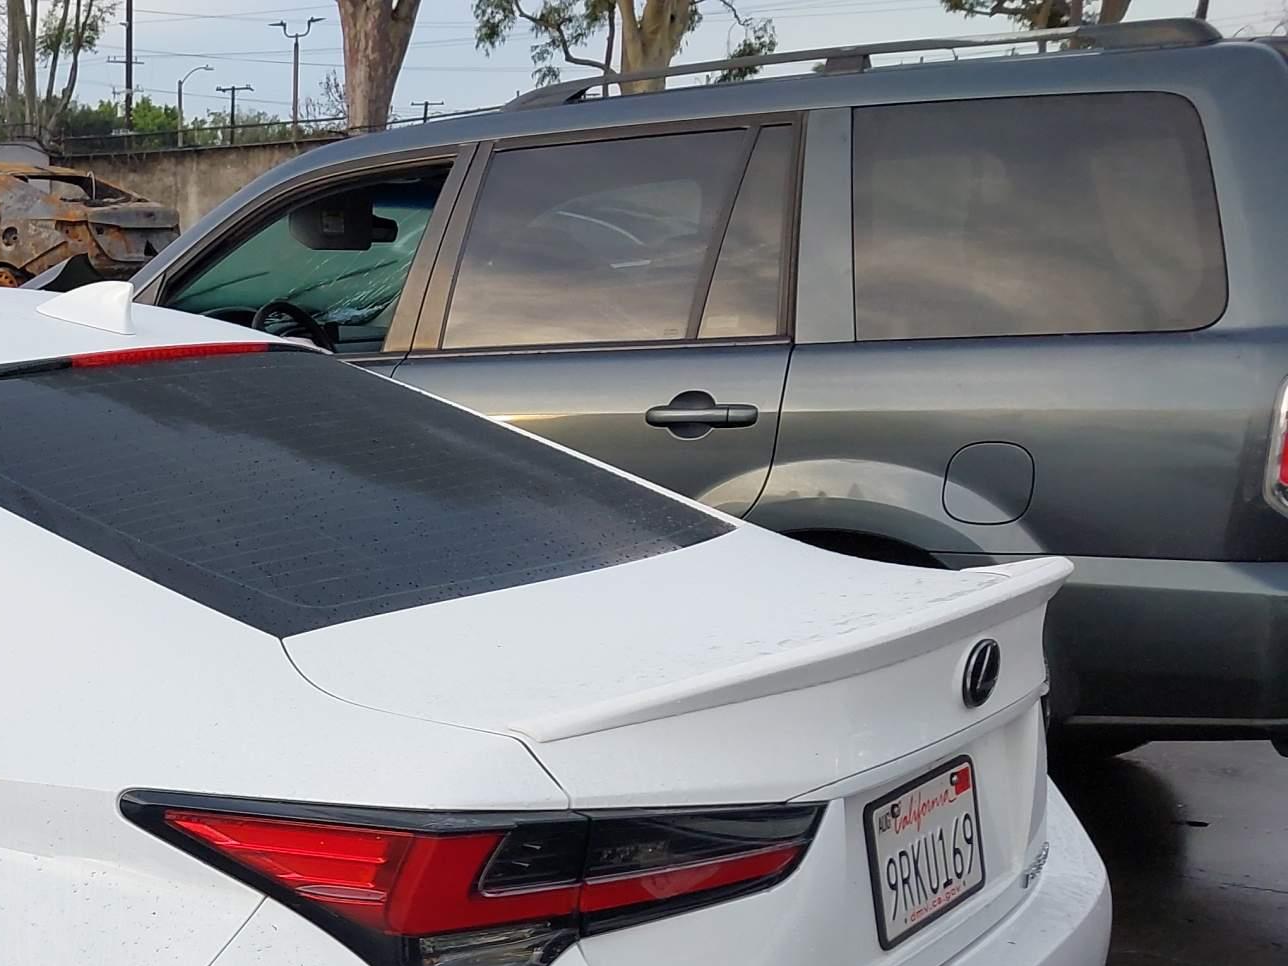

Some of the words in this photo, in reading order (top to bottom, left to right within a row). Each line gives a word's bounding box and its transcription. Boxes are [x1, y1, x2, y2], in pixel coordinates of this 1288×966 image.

[891, 788, 955, 834] California
[886, 812, 974, 921] 9RKU169
[910, 884, 960, 922] dmv.ca.gov
